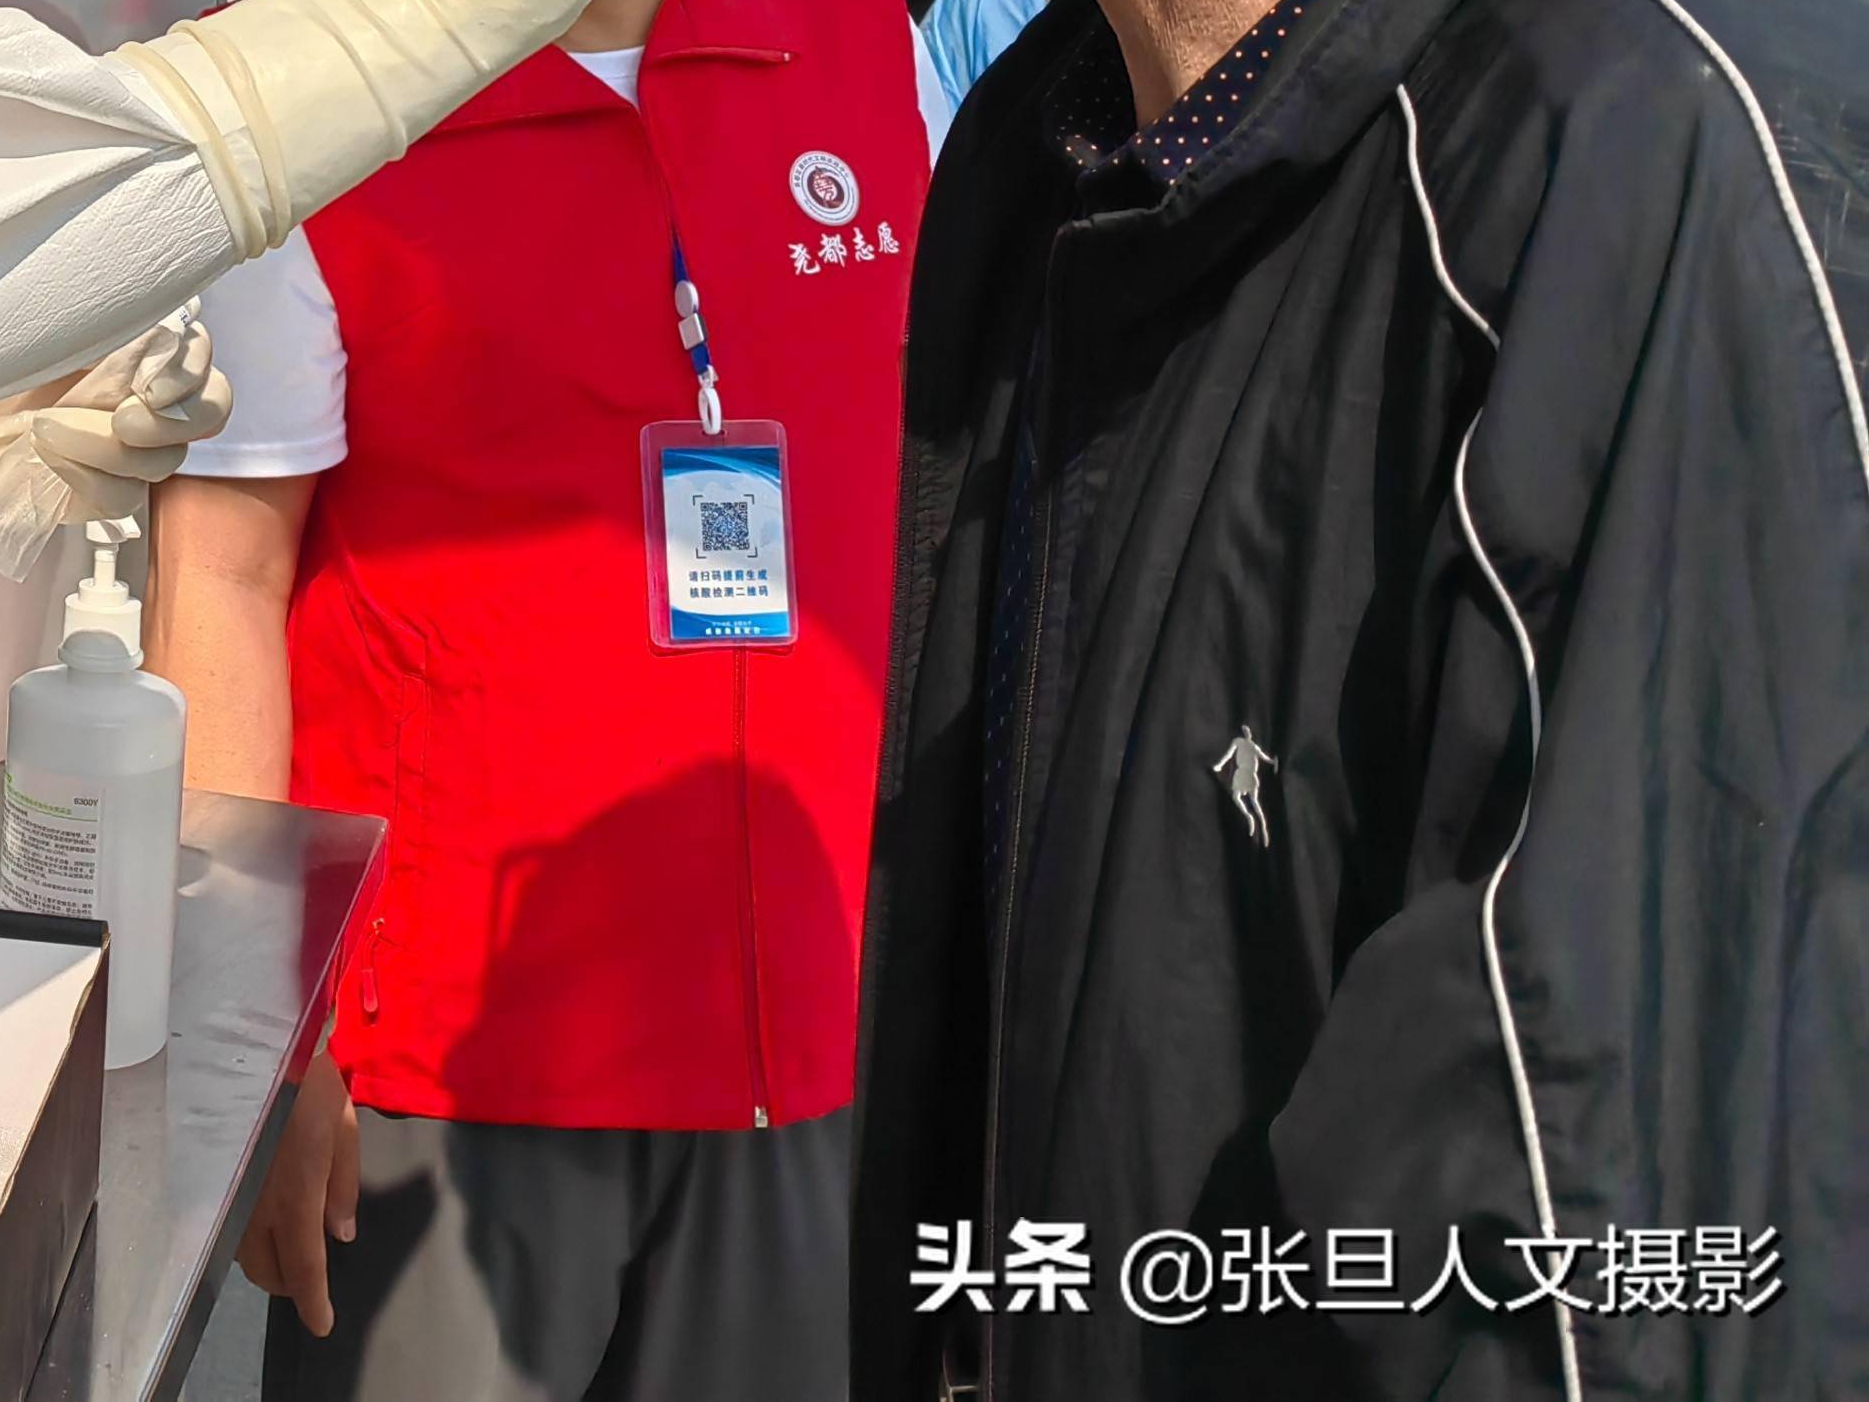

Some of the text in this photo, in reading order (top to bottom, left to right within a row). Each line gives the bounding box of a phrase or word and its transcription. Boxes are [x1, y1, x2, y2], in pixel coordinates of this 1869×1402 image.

[688, 568, 768, 582] 请扫码提前生成
[689, 585, 769, 598] 核酸检测二维码
